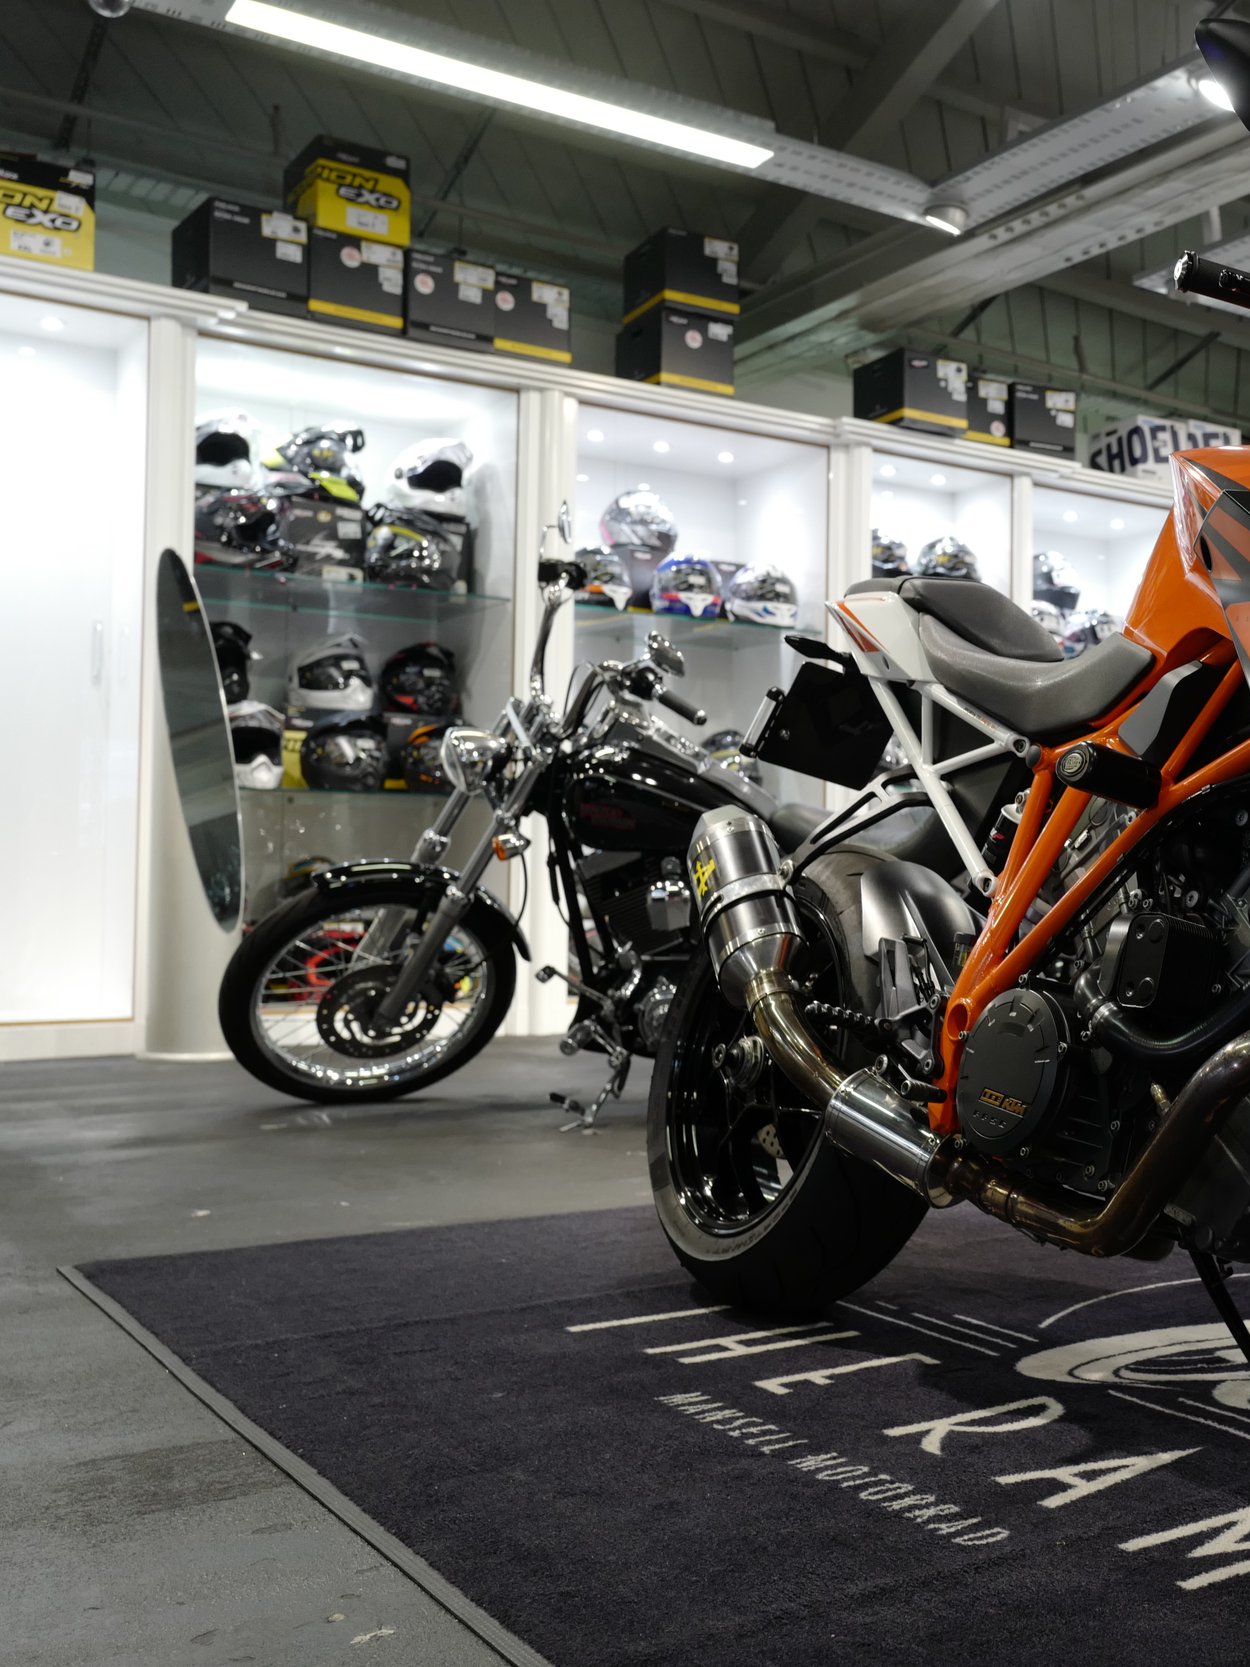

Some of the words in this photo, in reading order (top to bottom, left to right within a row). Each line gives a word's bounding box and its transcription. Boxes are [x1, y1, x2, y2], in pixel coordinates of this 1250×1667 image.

[338, 184, 400, 210] EXO
[5, 205, 81, 231] EXO
[654, 1392, 808, 1453] MANSELL
[787, 1453, 1010, 1546] MOTORRAD
